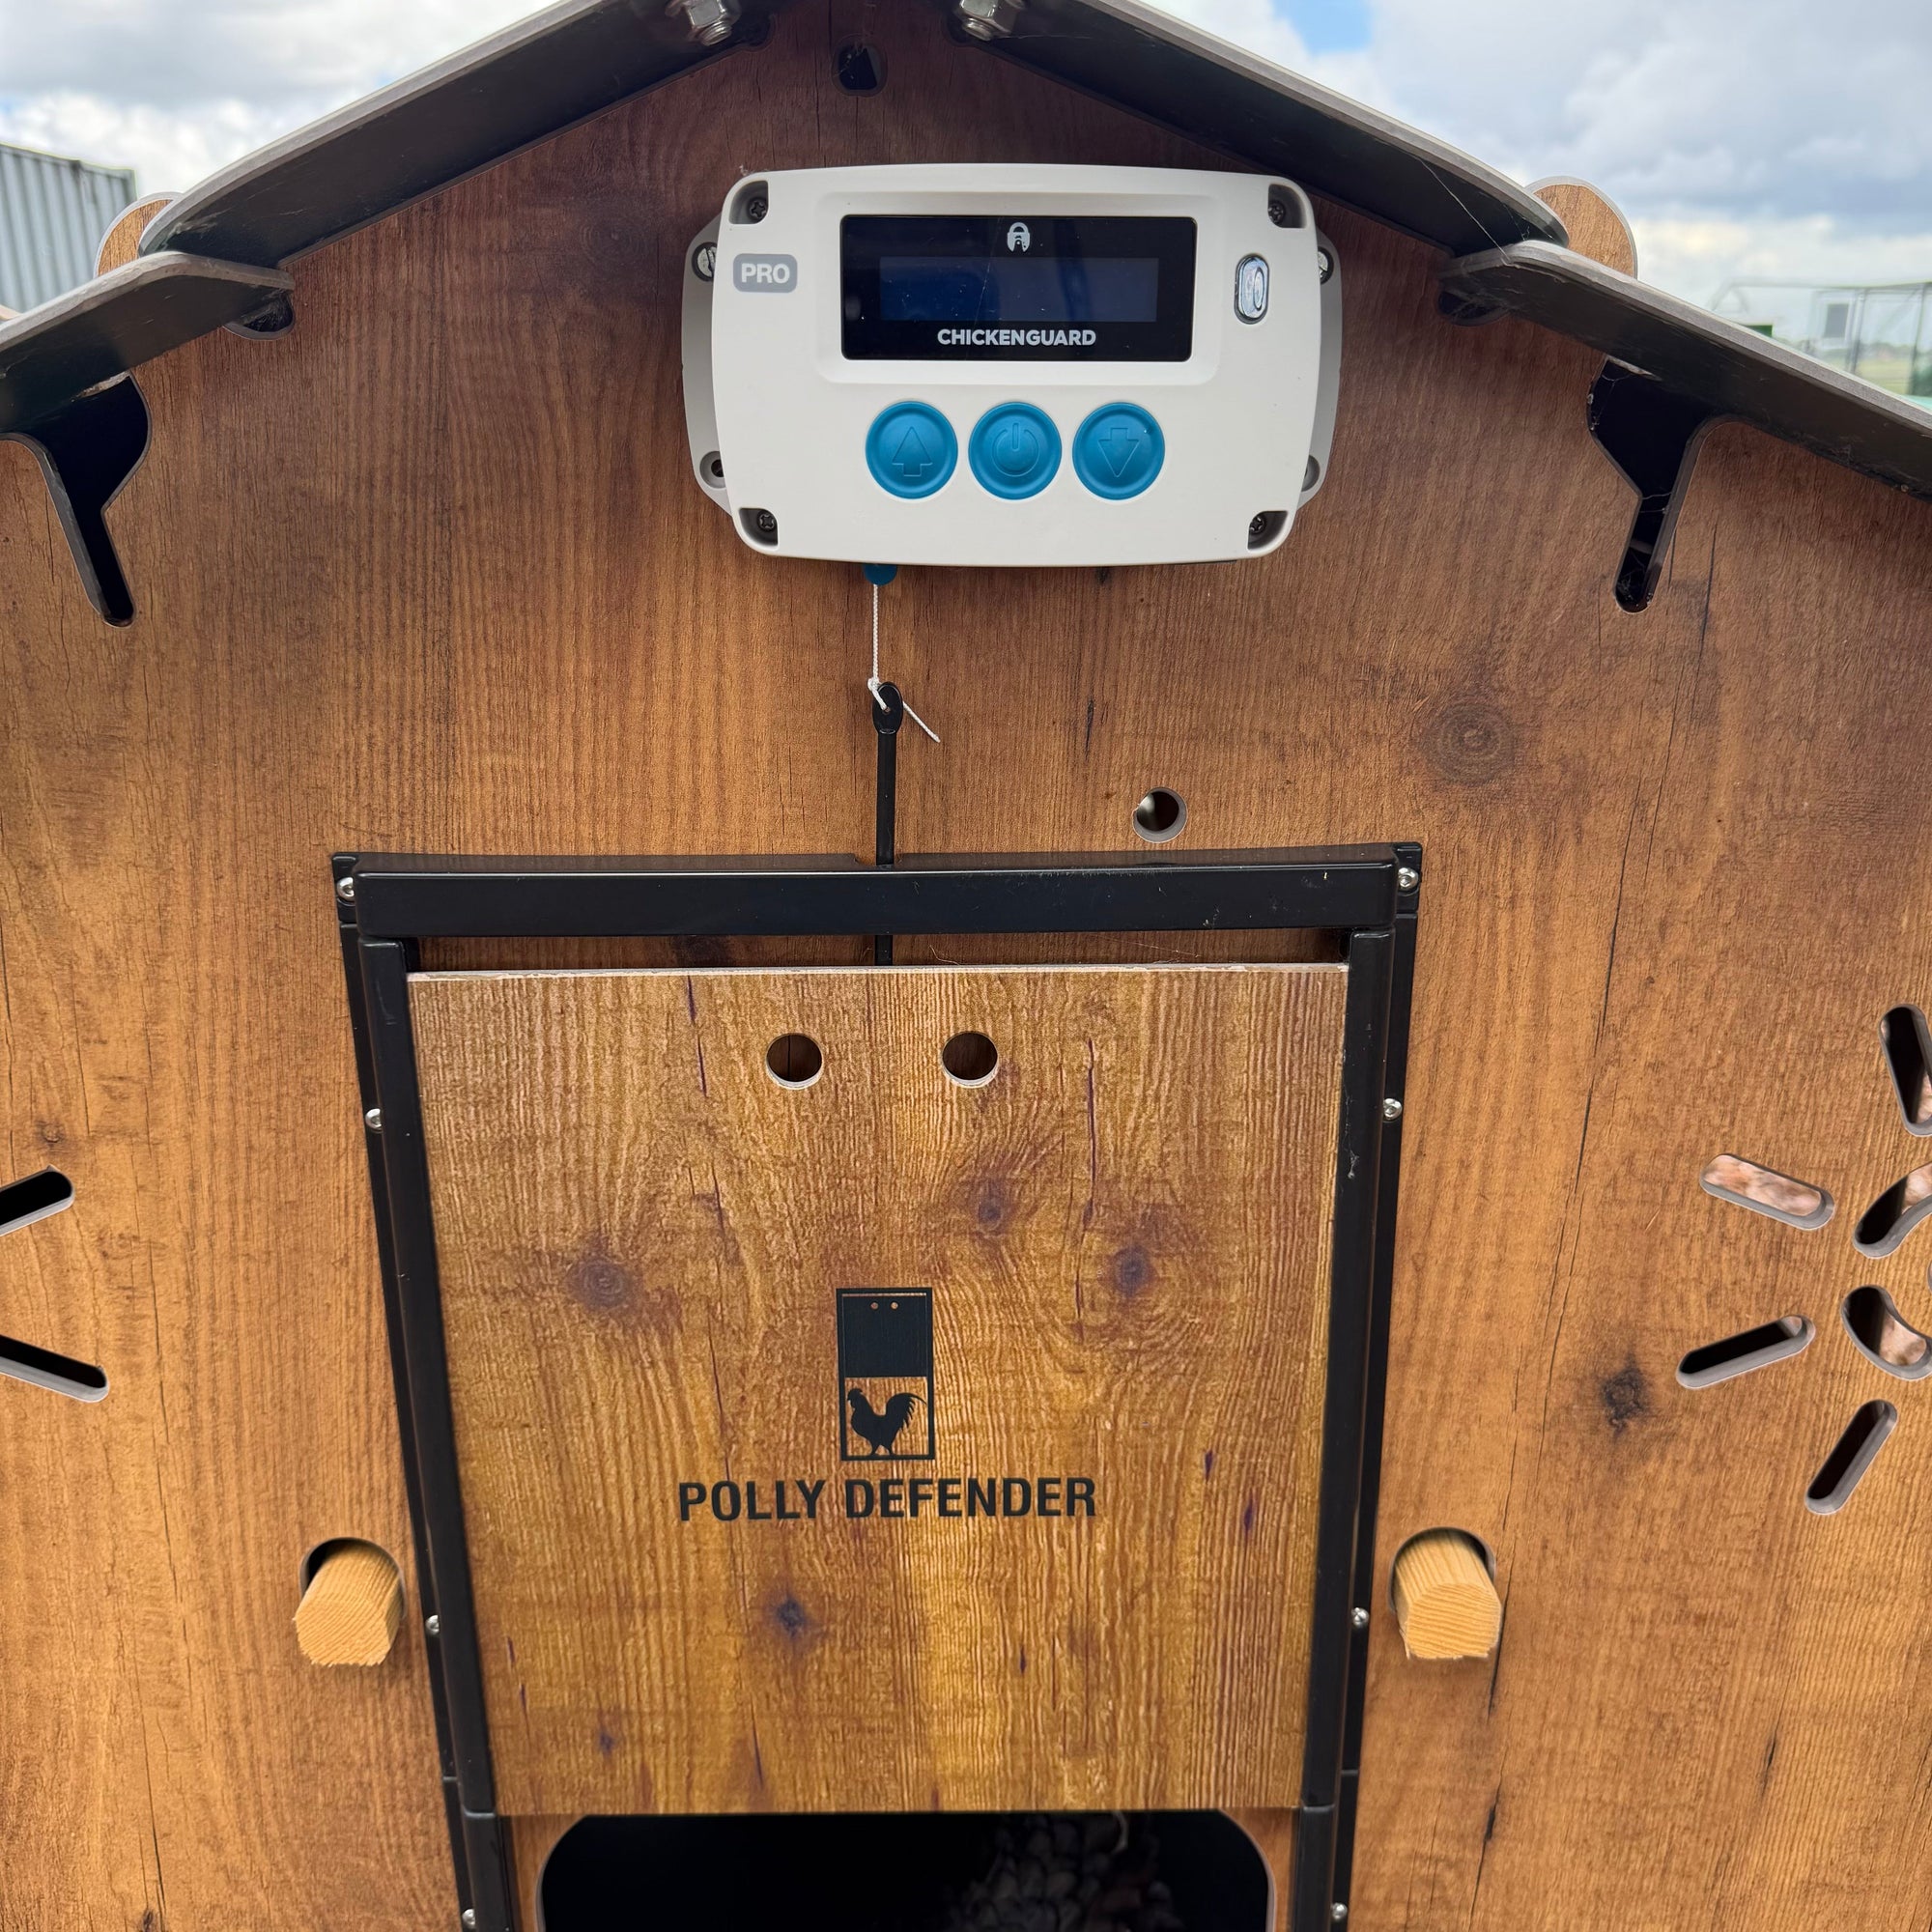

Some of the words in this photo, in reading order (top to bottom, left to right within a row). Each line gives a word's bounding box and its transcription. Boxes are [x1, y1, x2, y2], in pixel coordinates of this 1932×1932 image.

[741, 263, 790, 284] PRO
[937, 328, 1096, 347] CHICKENGUARD
[678, 1480, 826, 1521] POLLY
[844, 1477, 1096, 1519] DEFENDER
